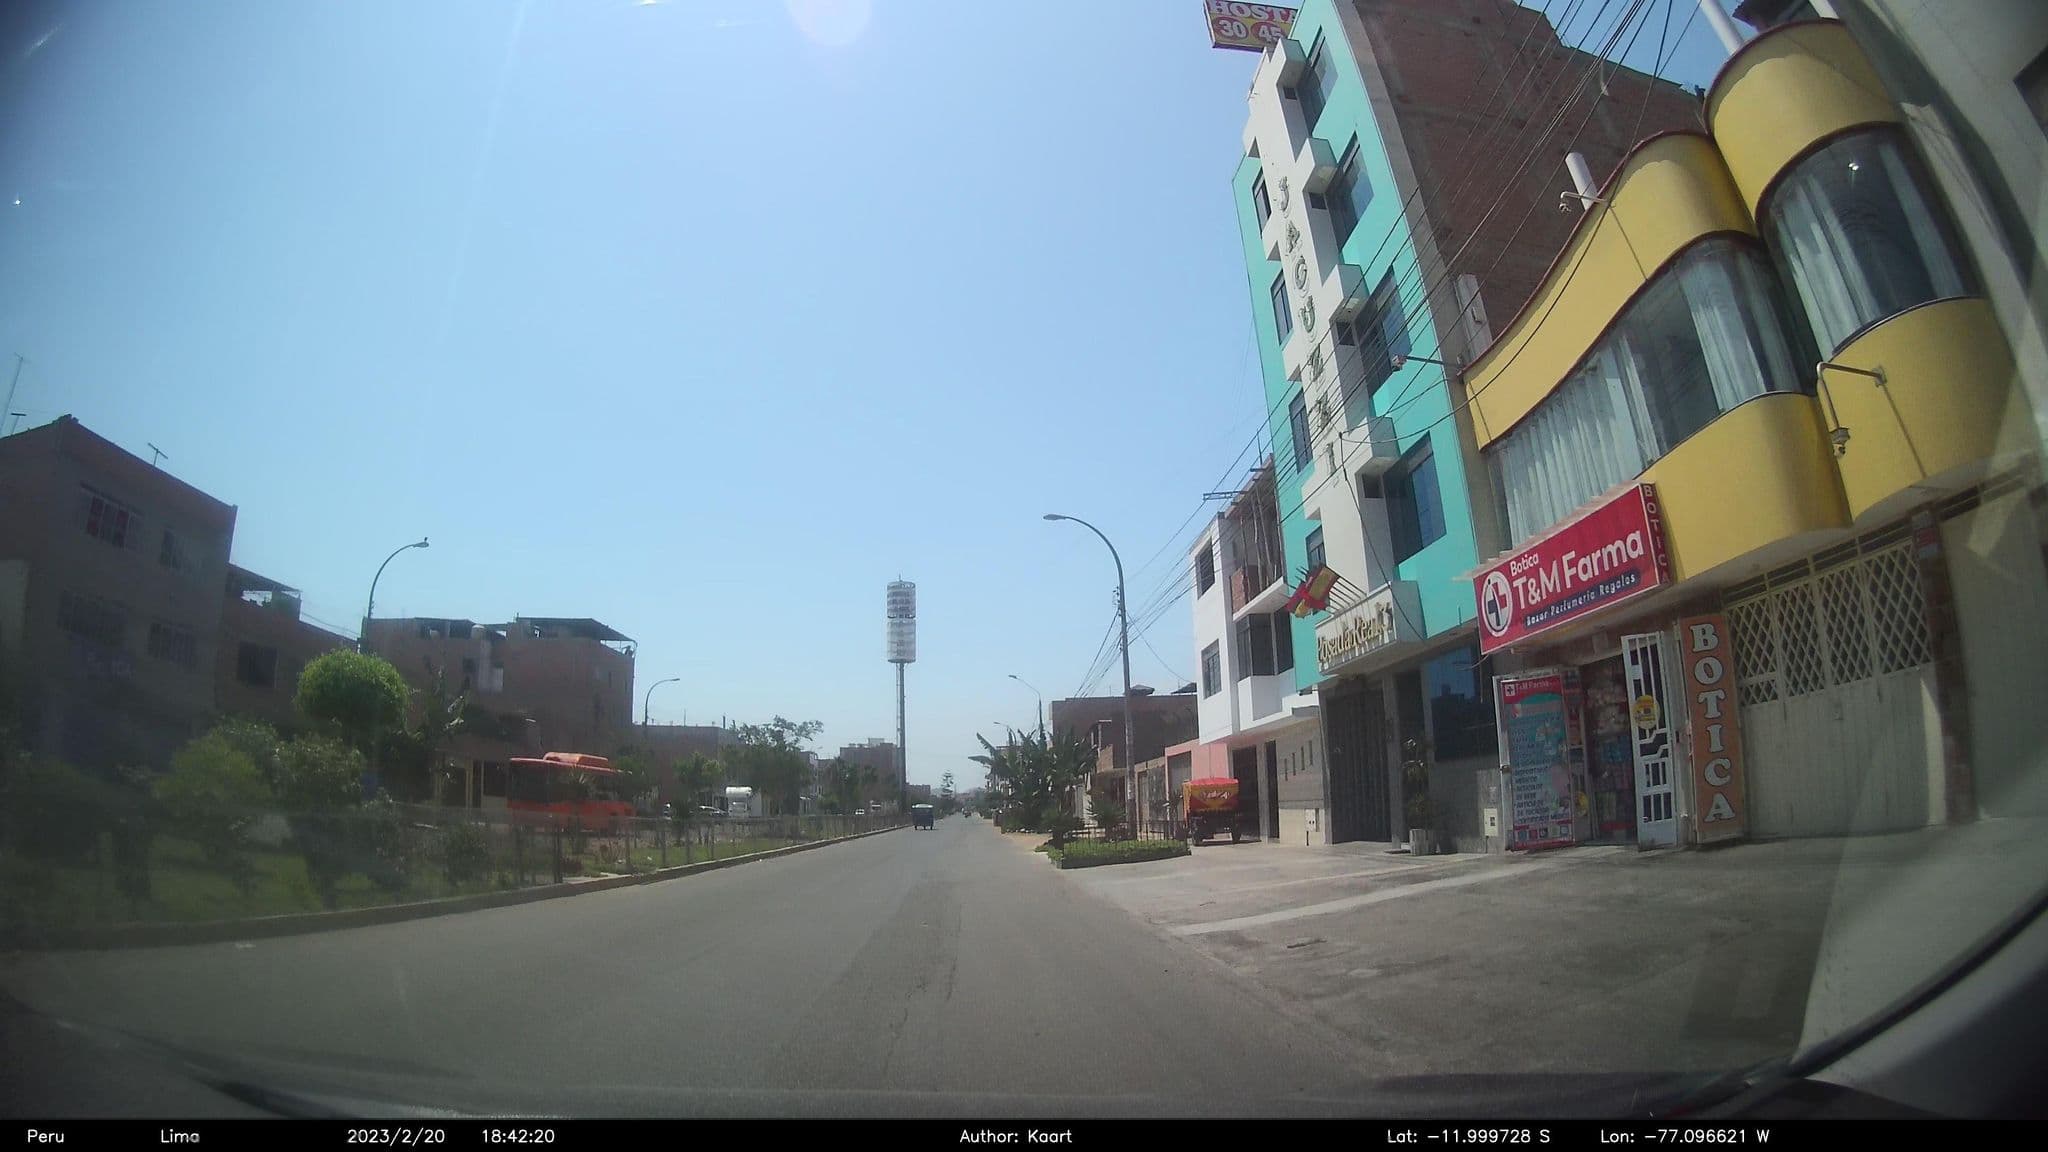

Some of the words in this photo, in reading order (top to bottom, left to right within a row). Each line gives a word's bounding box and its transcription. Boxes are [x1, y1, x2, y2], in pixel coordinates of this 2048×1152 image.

[1218, 19, 1247, 39] 30
[1258, 25, 1283, 42] 45
[1510, 552, 1539, 577] Botica
[1643, 485, 1670, 586] BOTICA
[1513, 561, 1561, 610] T&M
[1562, 530, 1645, 589] Farma
[1526, 611, 1548, 626] Bazar
[1599, 573, 1636, 595] Regalos
[1689, 623, 1736, 823] BOTICA
